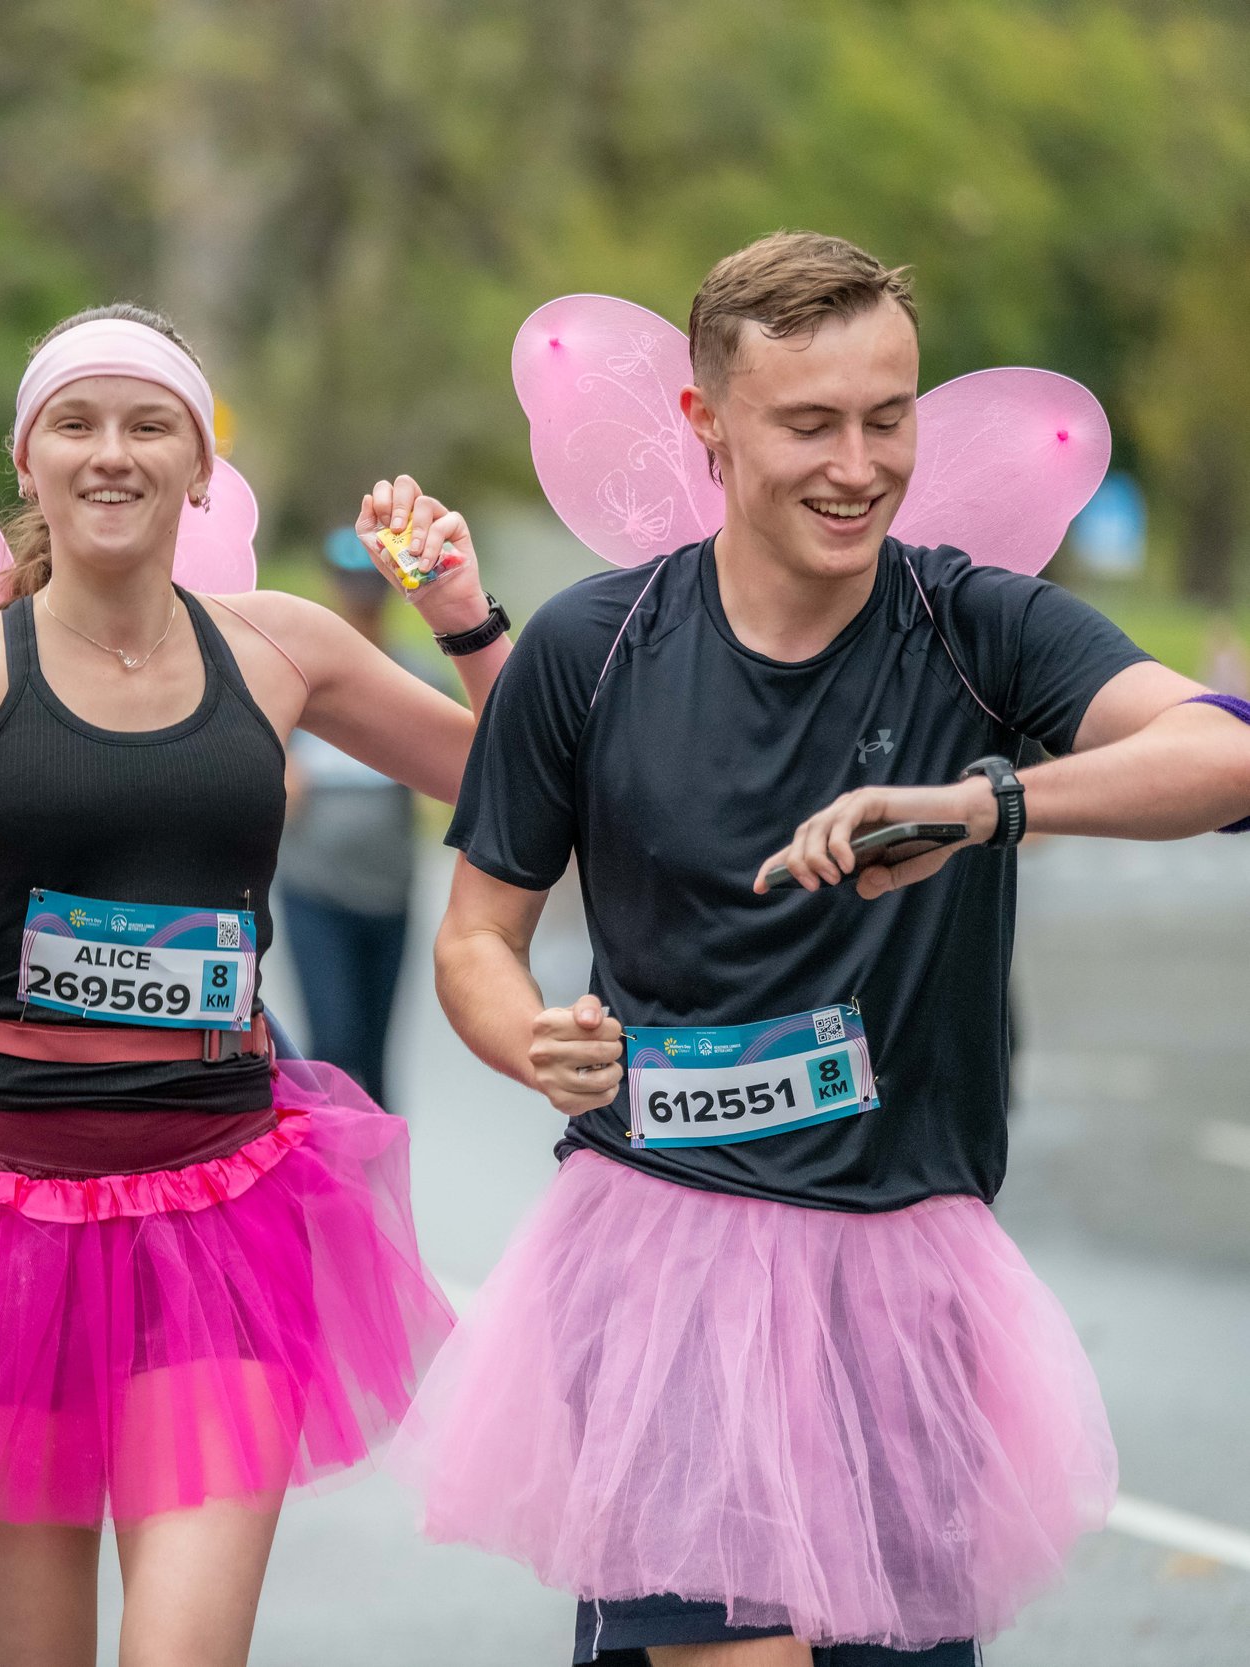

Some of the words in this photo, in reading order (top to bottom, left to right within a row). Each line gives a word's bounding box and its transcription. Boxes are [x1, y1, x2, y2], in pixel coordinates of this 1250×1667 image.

[74, 946, 152, 970] ALICE
[211, 965, 228, 988] 8
[28, 965, 191, 1016] 269569
[206, 994, 230, 1009] KM
[818, 1059, 841, 1082] 8
[648, 1078, 796, 1124] 612551
[819, 1080, 848, 1100] KM
